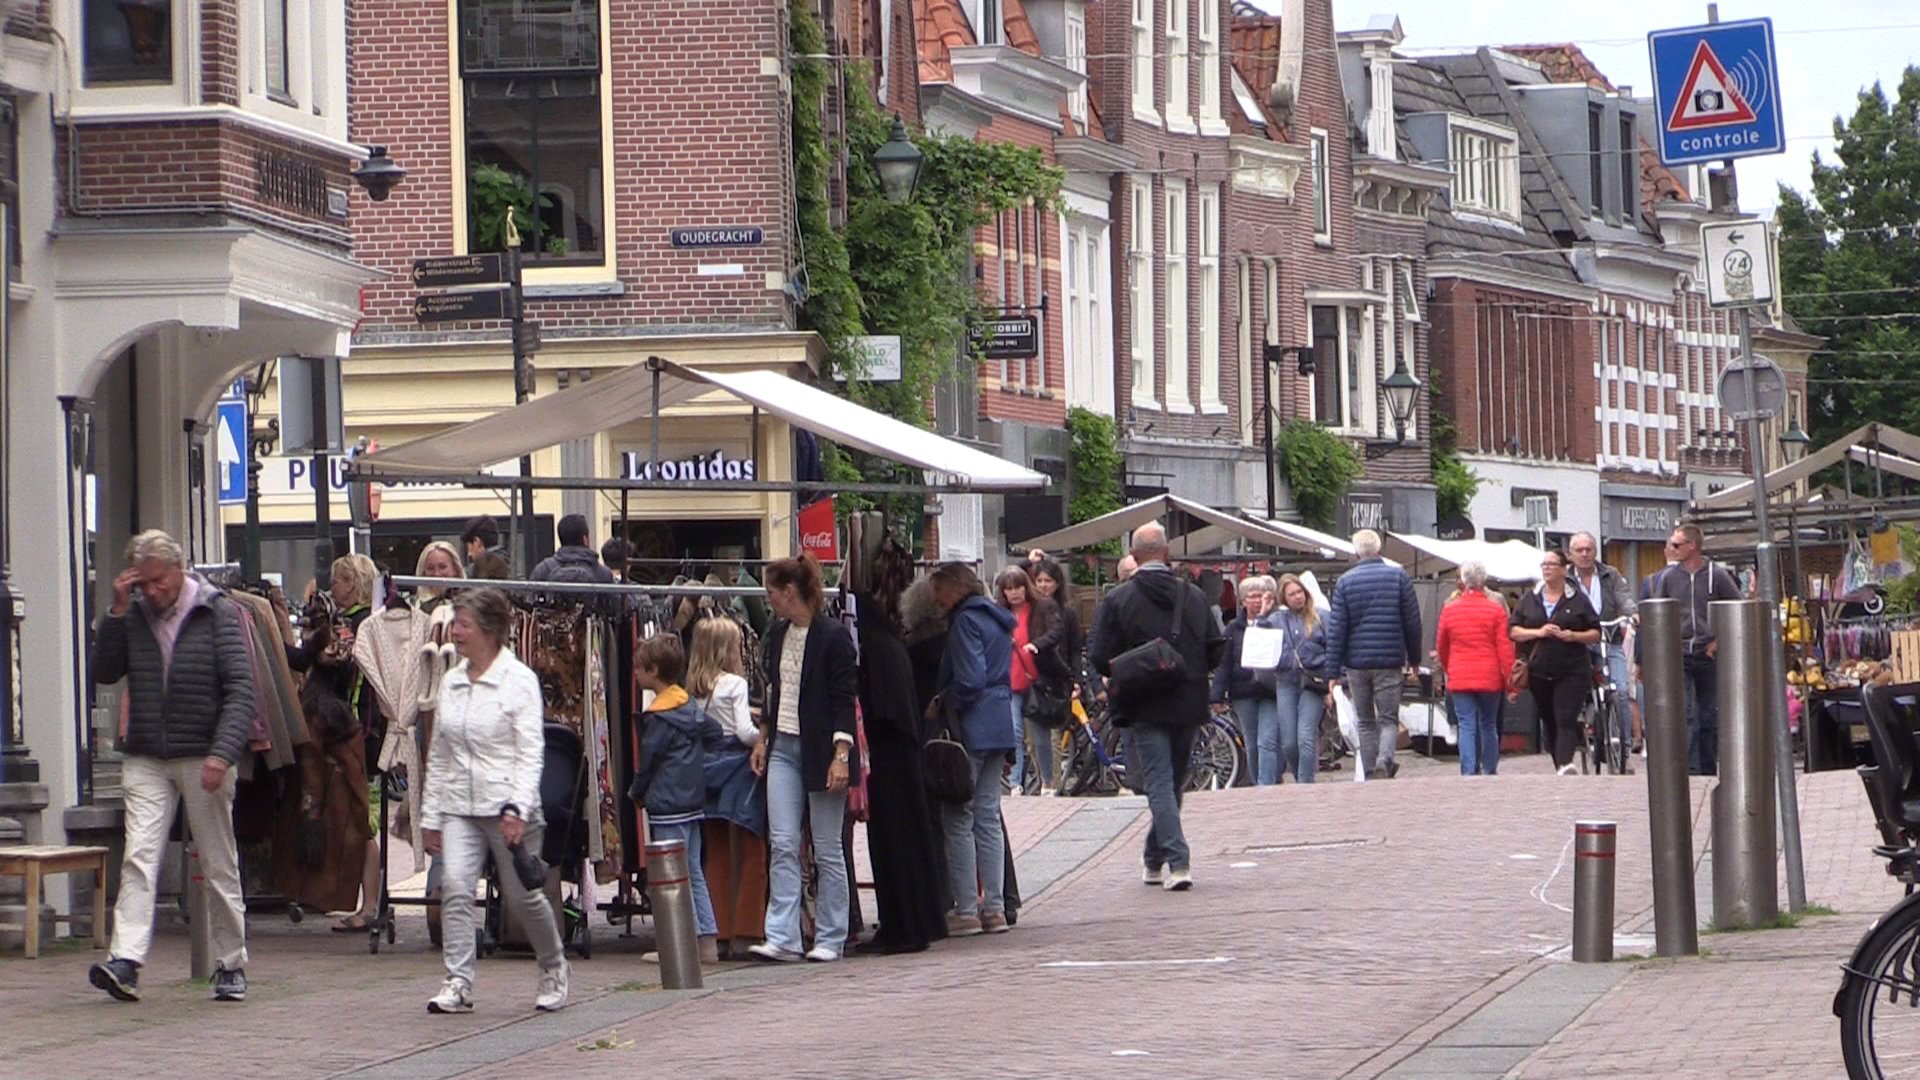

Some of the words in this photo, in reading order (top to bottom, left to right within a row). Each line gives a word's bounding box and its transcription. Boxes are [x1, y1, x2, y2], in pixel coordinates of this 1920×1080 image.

[1681, 129, 1759, 151] controle
[680, 231, 754, 244] OUDEGRACHT
[621, 449, 753, 480] Leonidas
[803, 532, 832, 548] Coca-Cola
